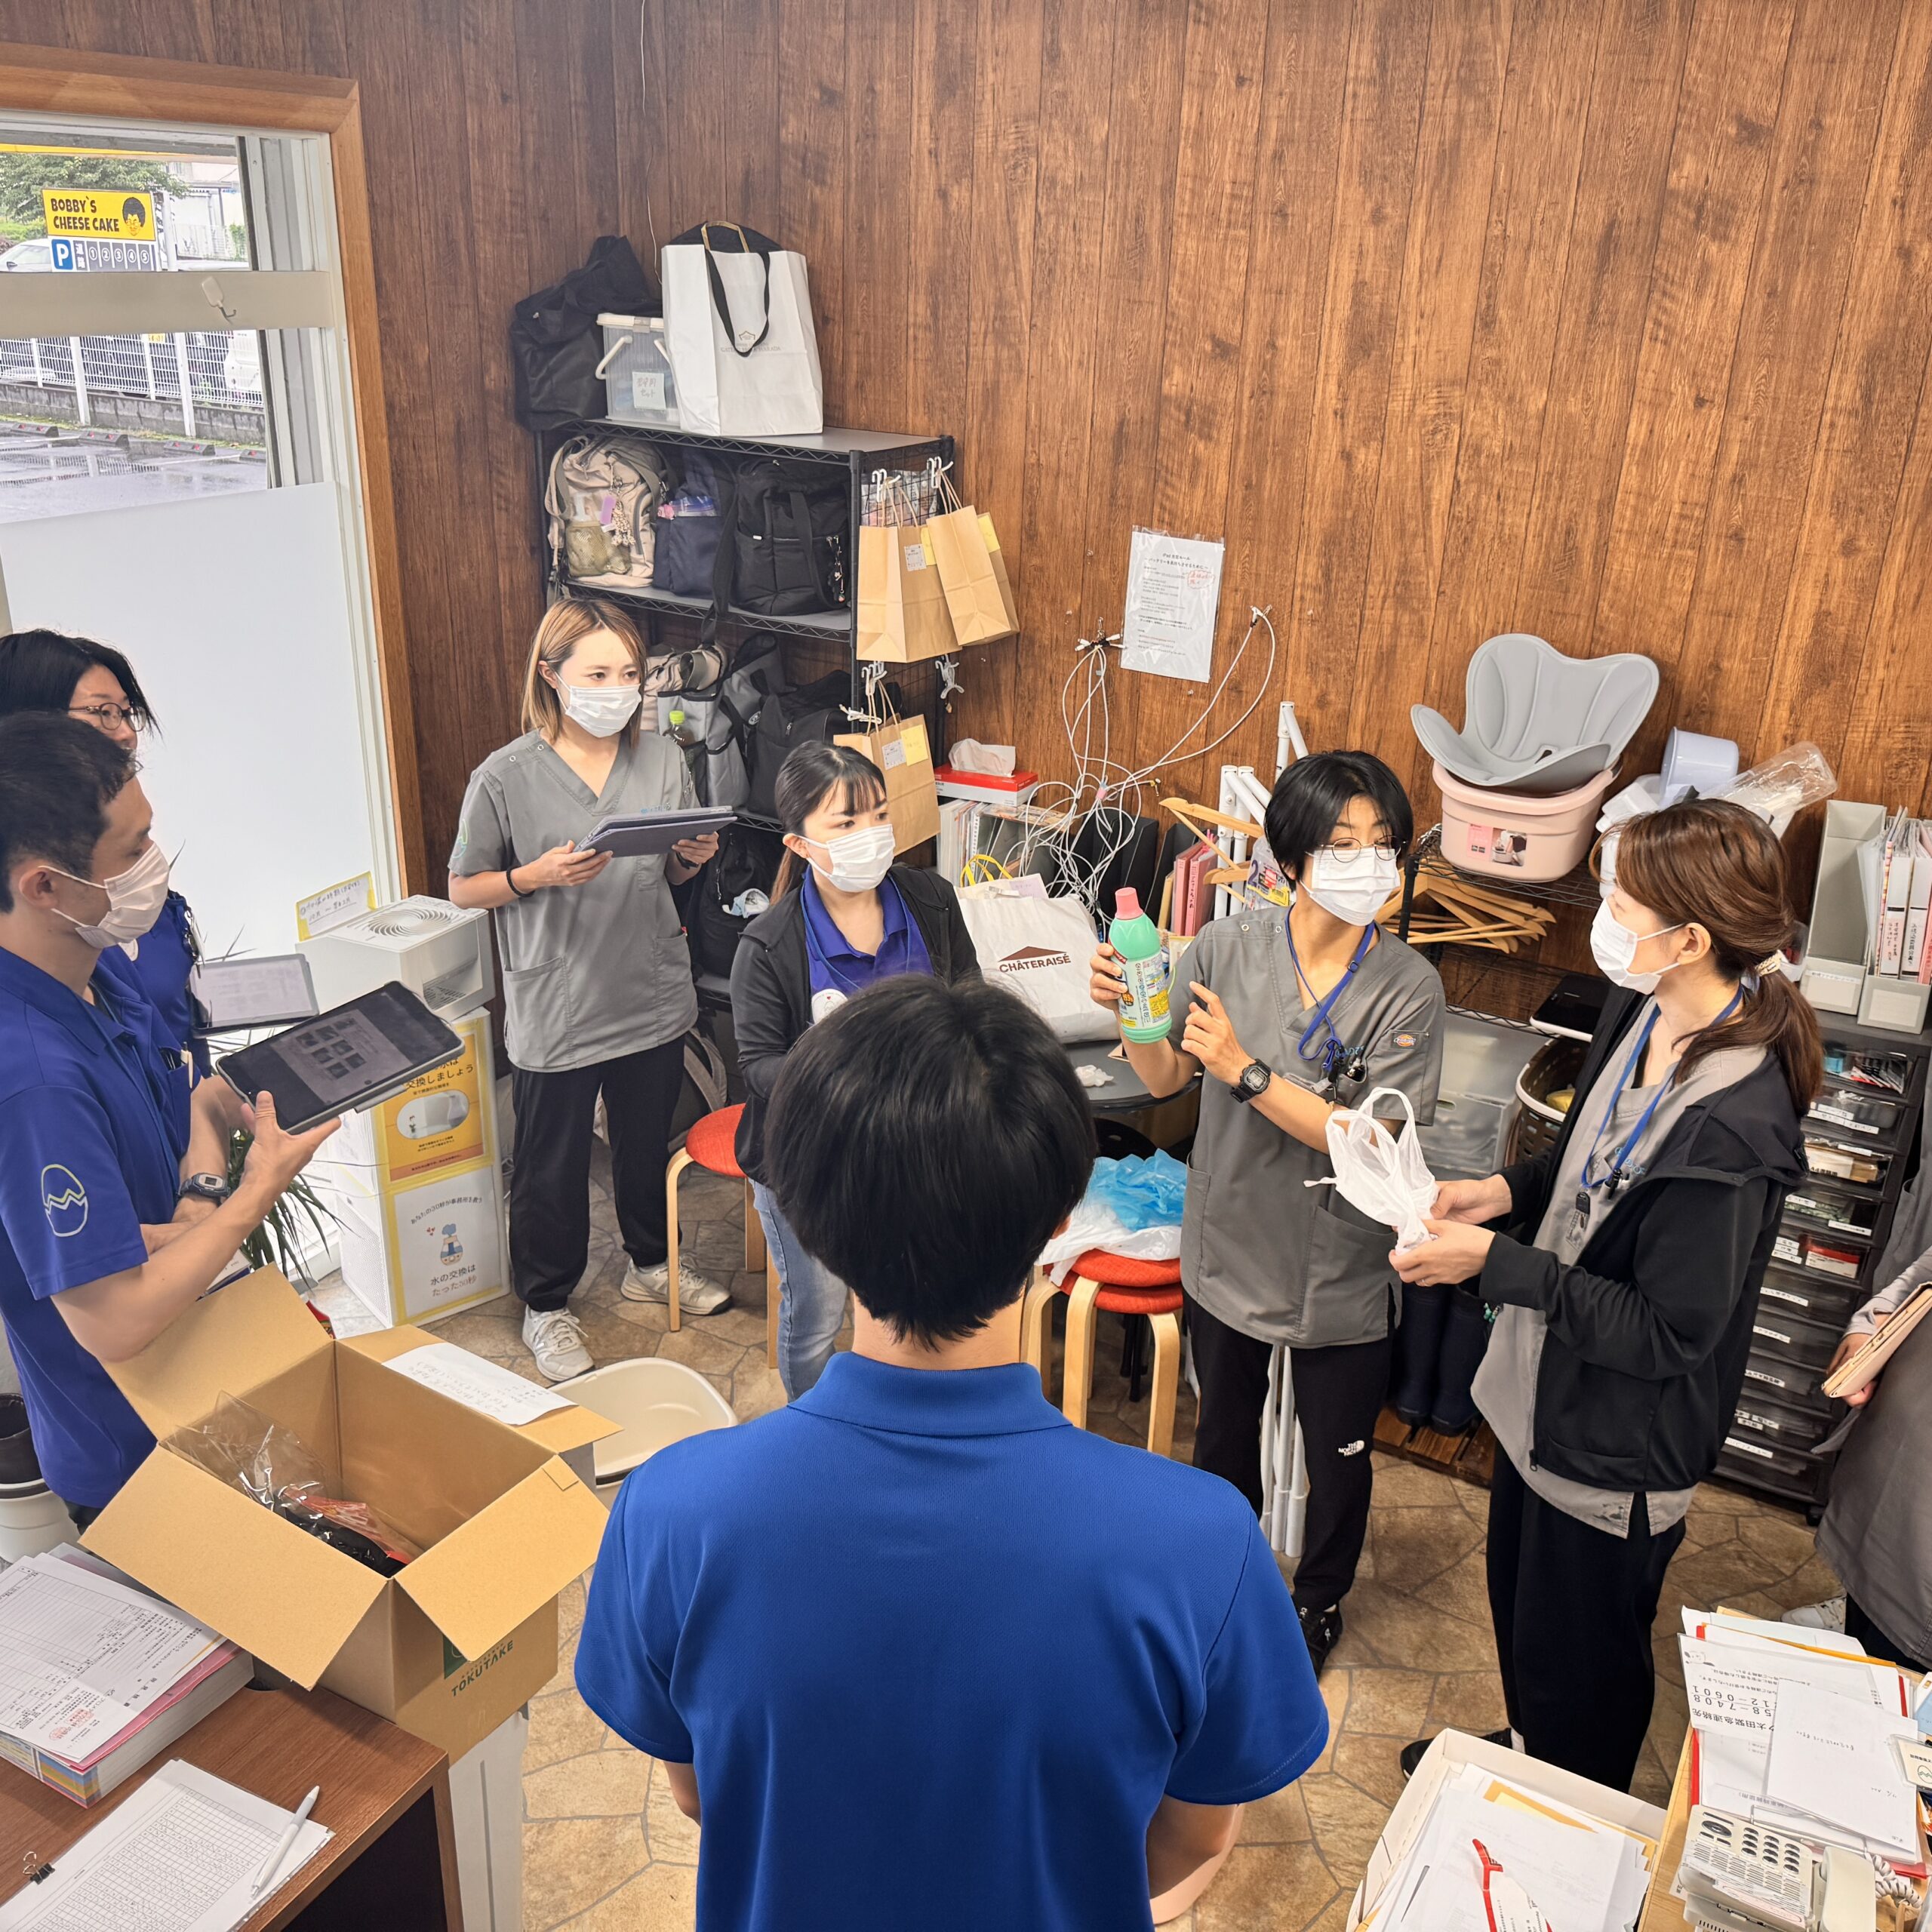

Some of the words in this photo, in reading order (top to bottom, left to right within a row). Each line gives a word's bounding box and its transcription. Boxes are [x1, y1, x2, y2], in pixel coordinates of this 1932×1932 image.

[54, 216, 91, 230] CHEESE
[92, 218, 119, 232] CAKE
[56, 243, 69, 266] P
[998, 953, 1072, 974] CHÂTERAISÉ
[407, 1064, 473, 1089] 交換しましょう
[431, 1264, 476, 1286] 水の交換は
[451, 1640, 513, 1697] TOKUTAKE
